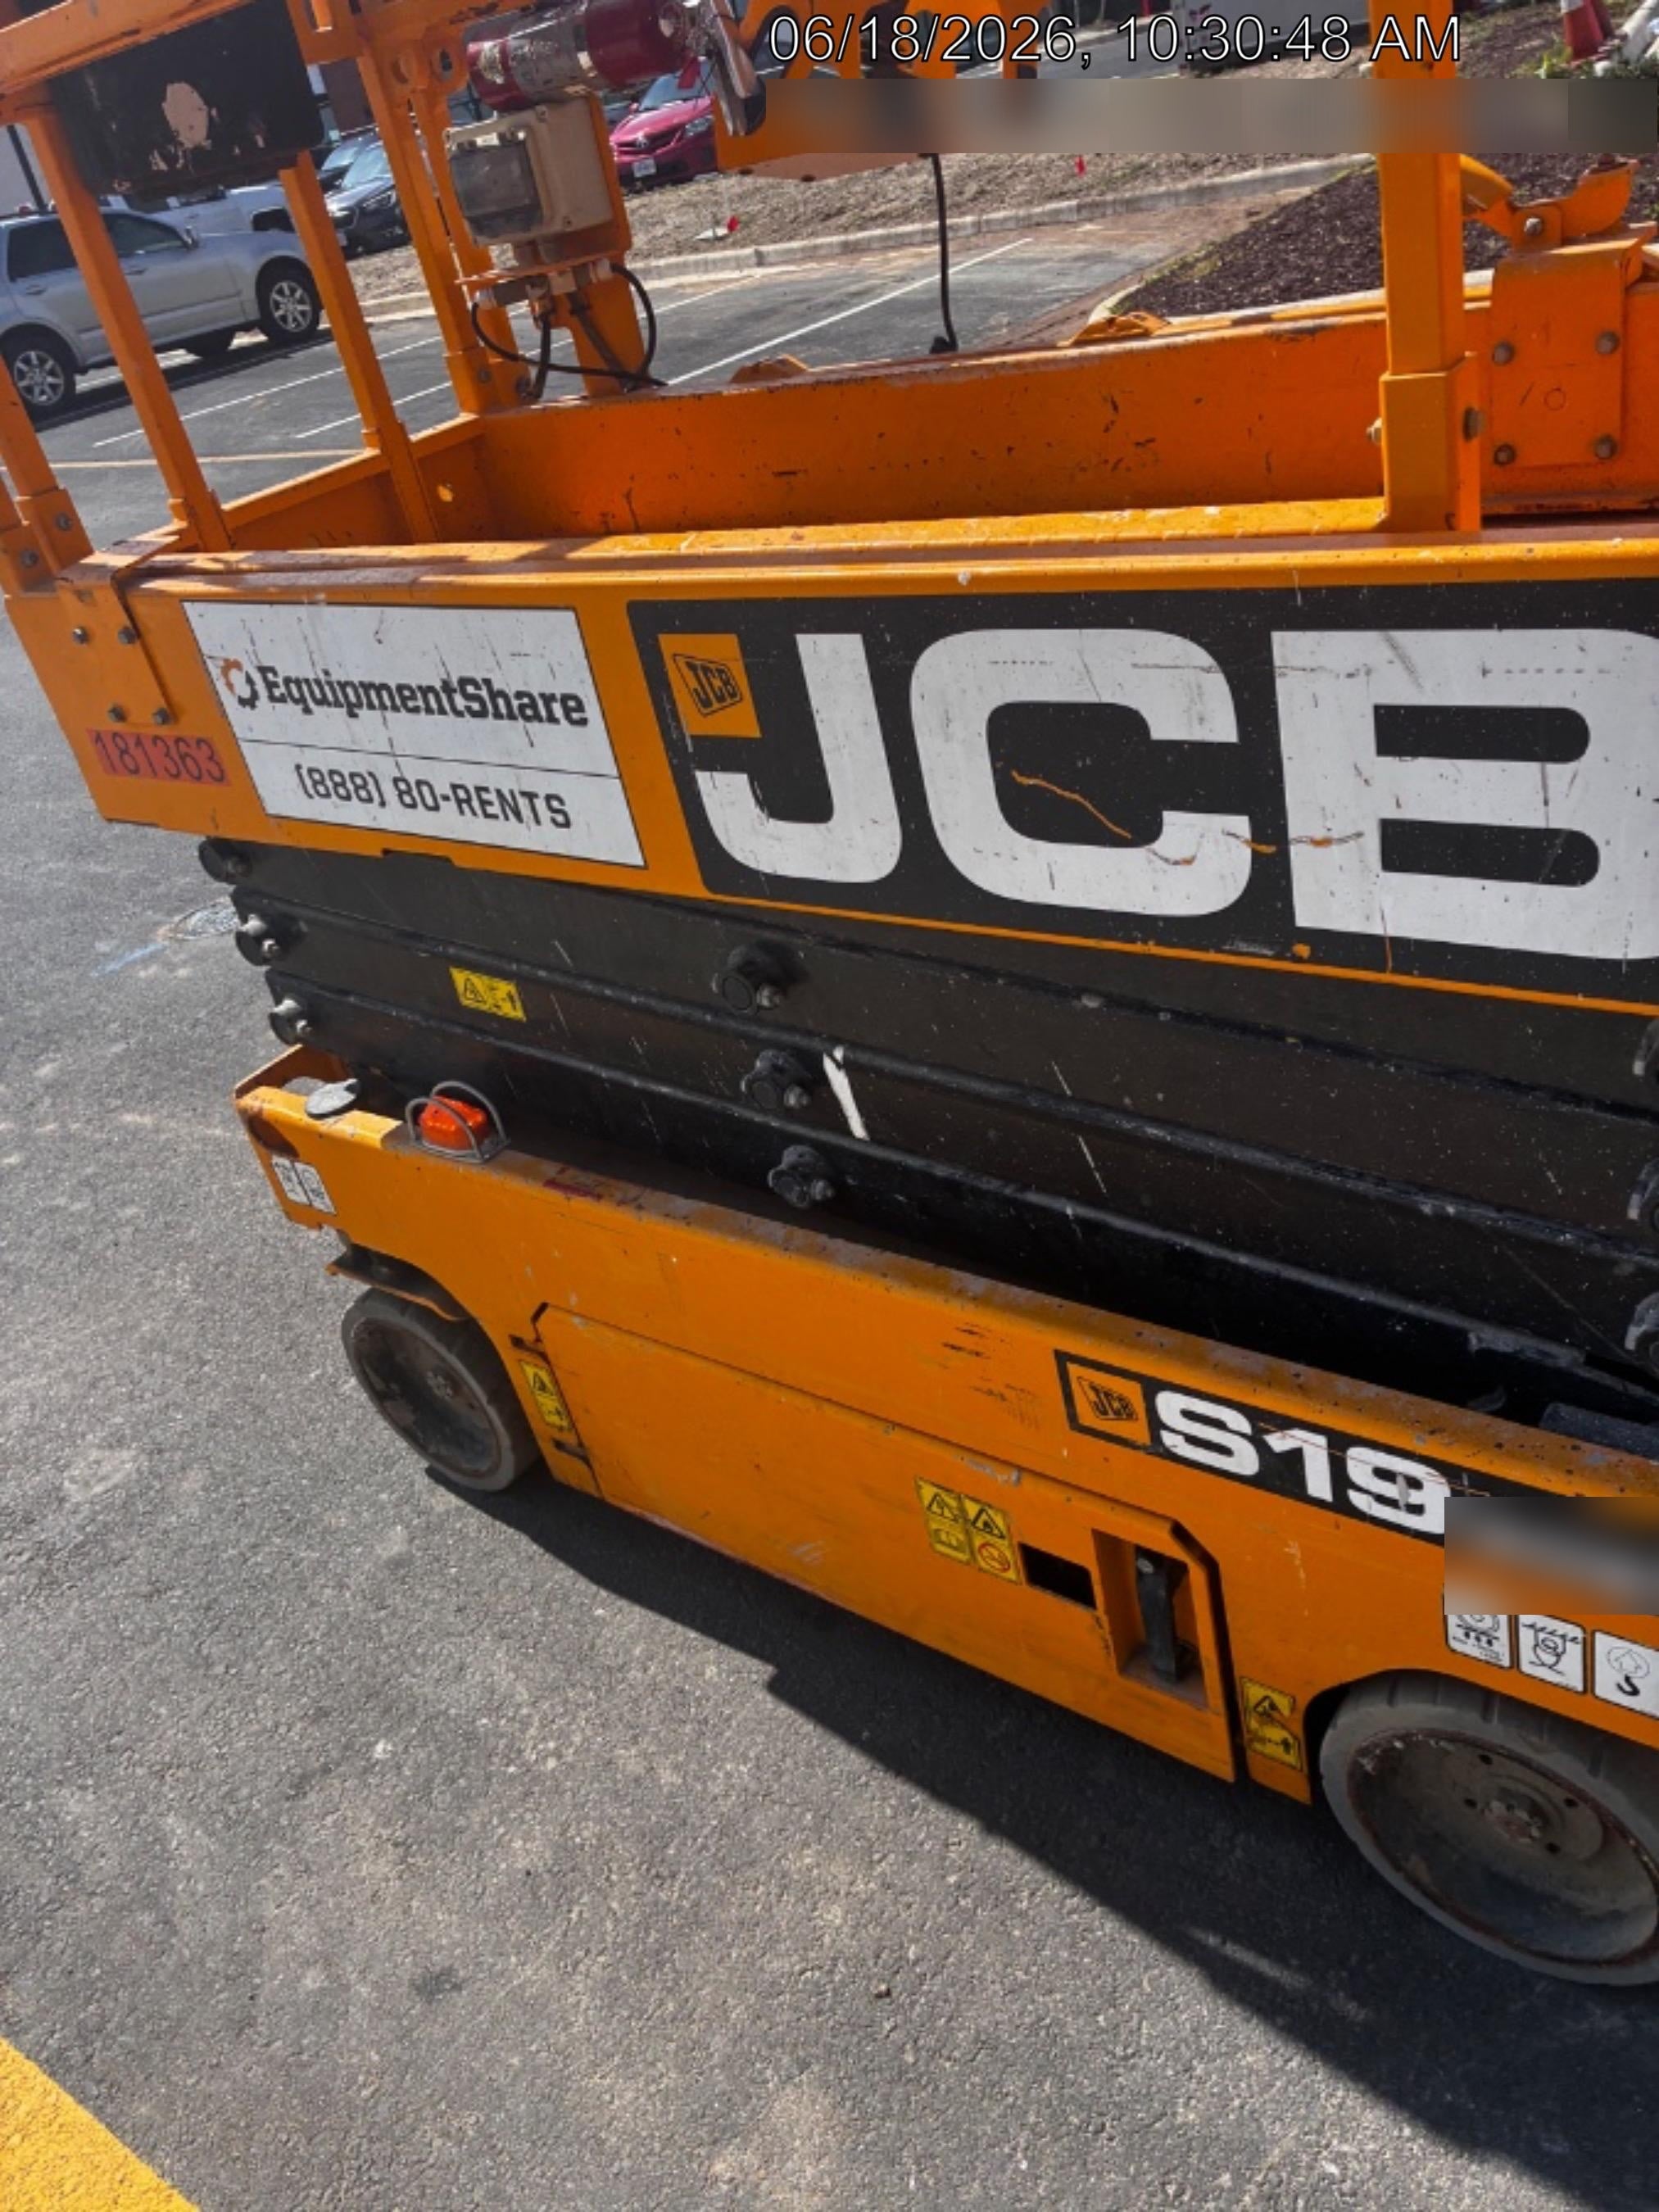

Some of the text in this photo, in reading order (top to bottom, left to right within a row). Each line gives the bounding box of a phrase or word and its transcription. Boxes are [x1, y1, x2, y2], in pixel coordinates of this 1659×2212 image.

[257, 665, 589, 728] EquipmentShare
[685, 660, 738, 709] JCB
[93, 730, 225, 782] 181363
[294, 764, 571, 829] (888) 80-RENTS
[695, 628, 1659, 960] JCB
[1090, 1381, 1137, 1421] JCB
